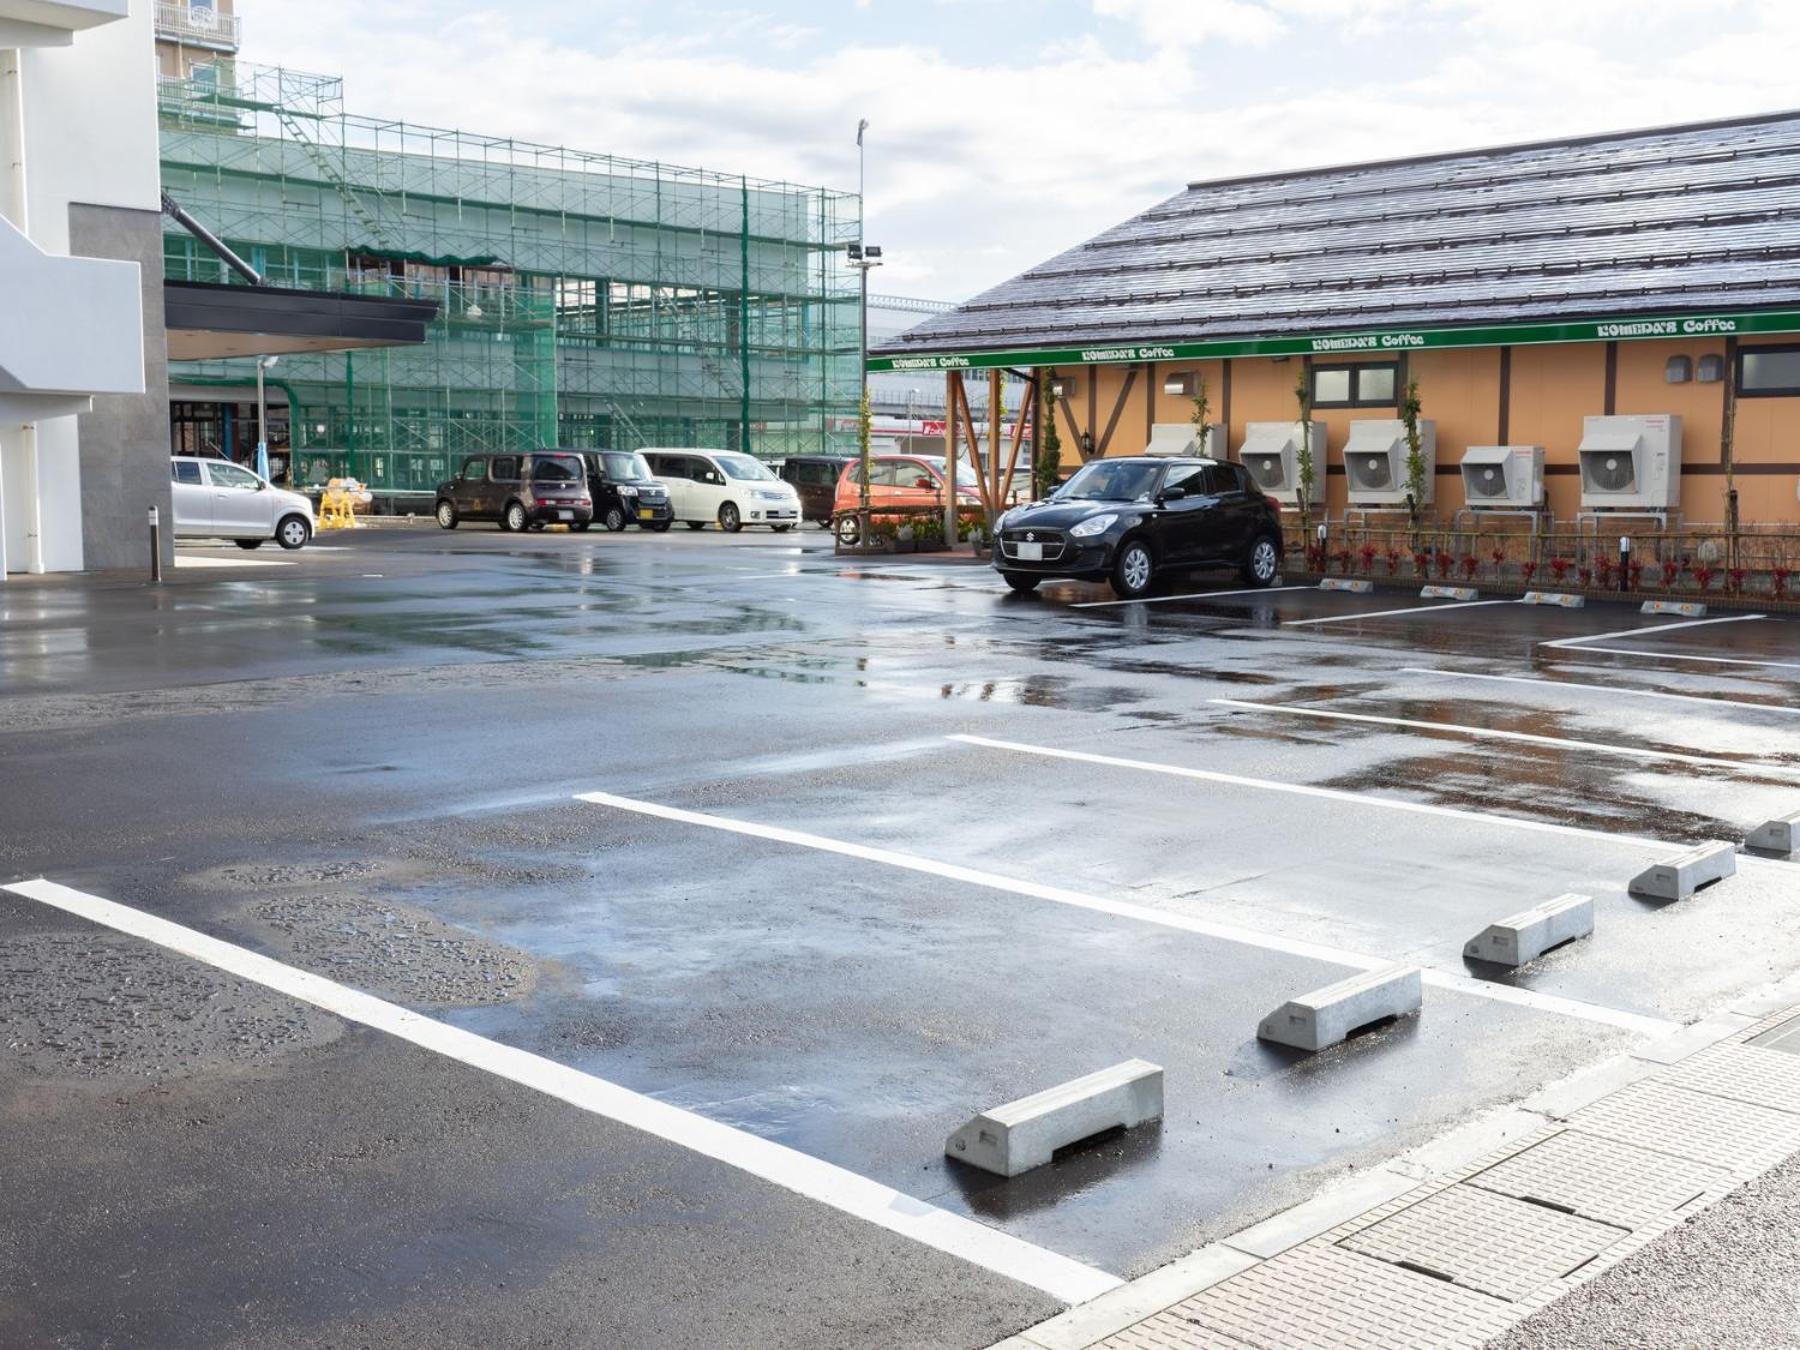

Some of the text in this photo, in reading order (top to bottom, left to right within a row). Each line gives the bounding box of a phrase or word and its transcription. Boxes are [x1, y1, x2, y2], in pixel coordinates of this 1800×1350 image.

[1597, 319, 1736, 336] KOMEDA'S Coffee
[1382, 335, 1424, 346] Coffee
[1140, 348, 1174, 358] Coffee
